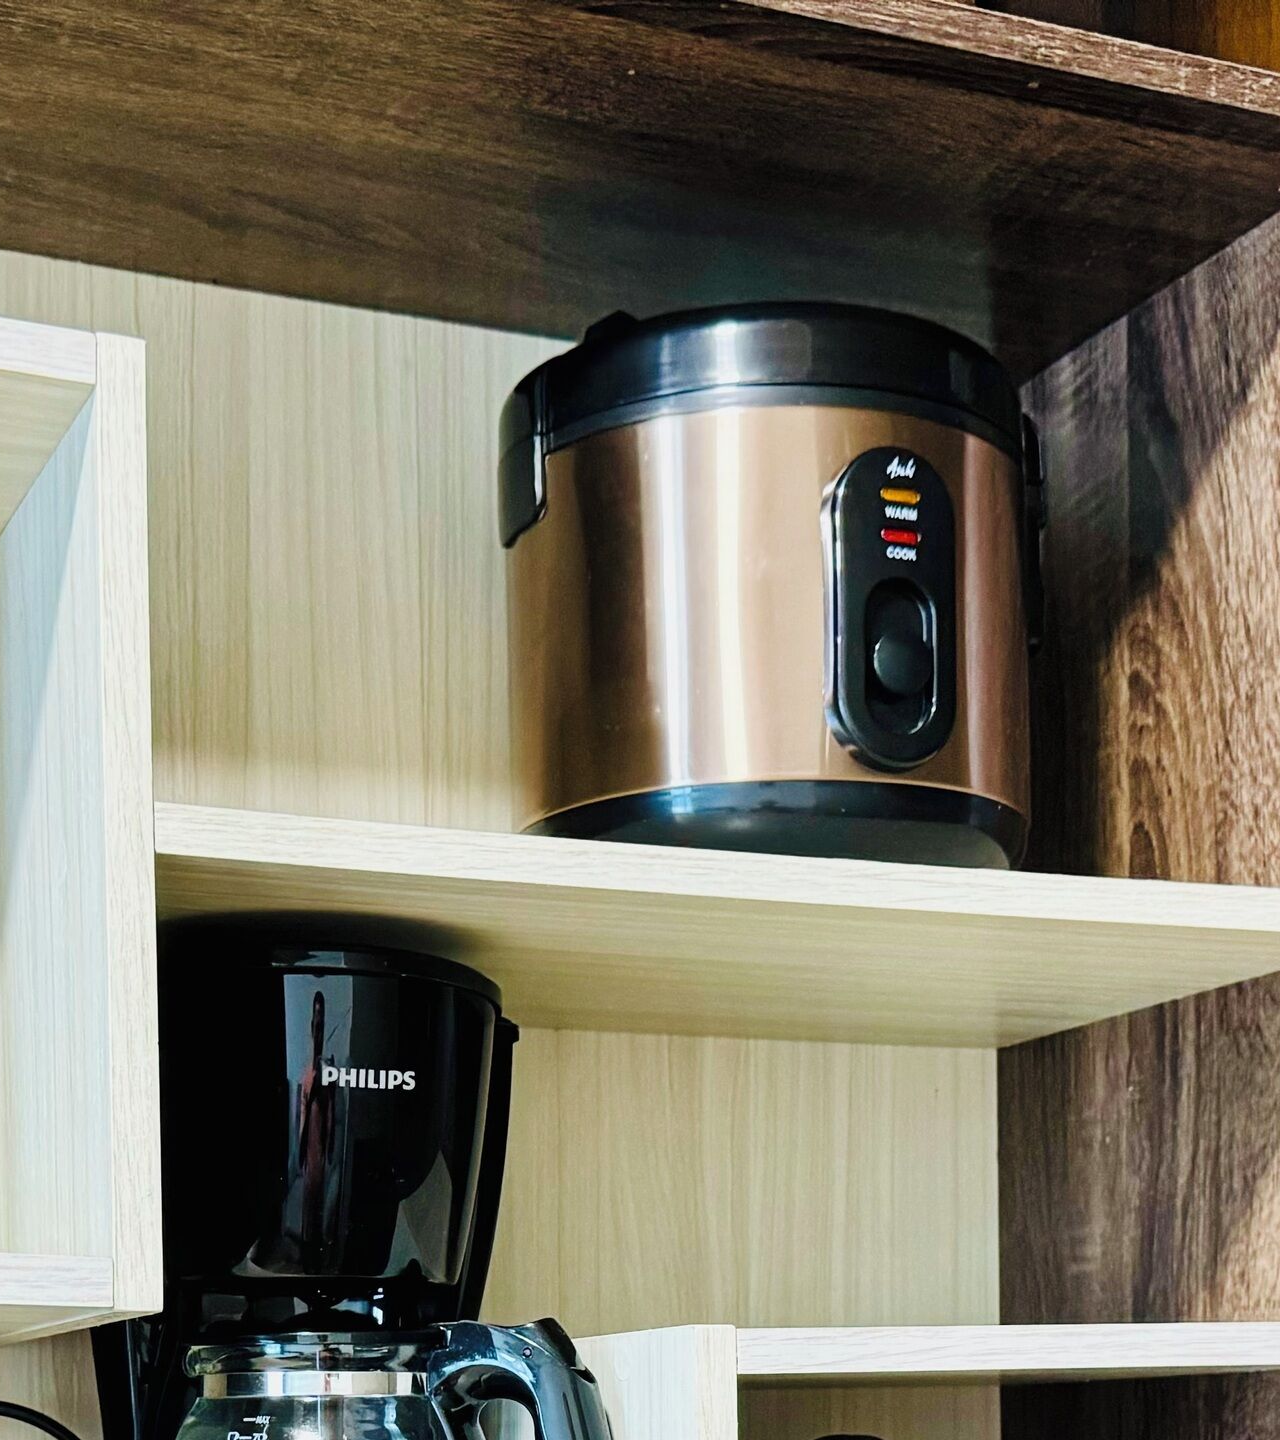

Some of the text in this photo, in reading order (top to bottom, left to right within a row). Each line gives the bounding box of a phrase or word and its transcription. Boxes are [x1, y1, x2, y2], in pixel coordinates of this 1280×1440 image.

[884, 504, 918, 522] WARM
[886, 545, 917, 562] COOK
[321, 1066, 416, 1091] PHILIPS
